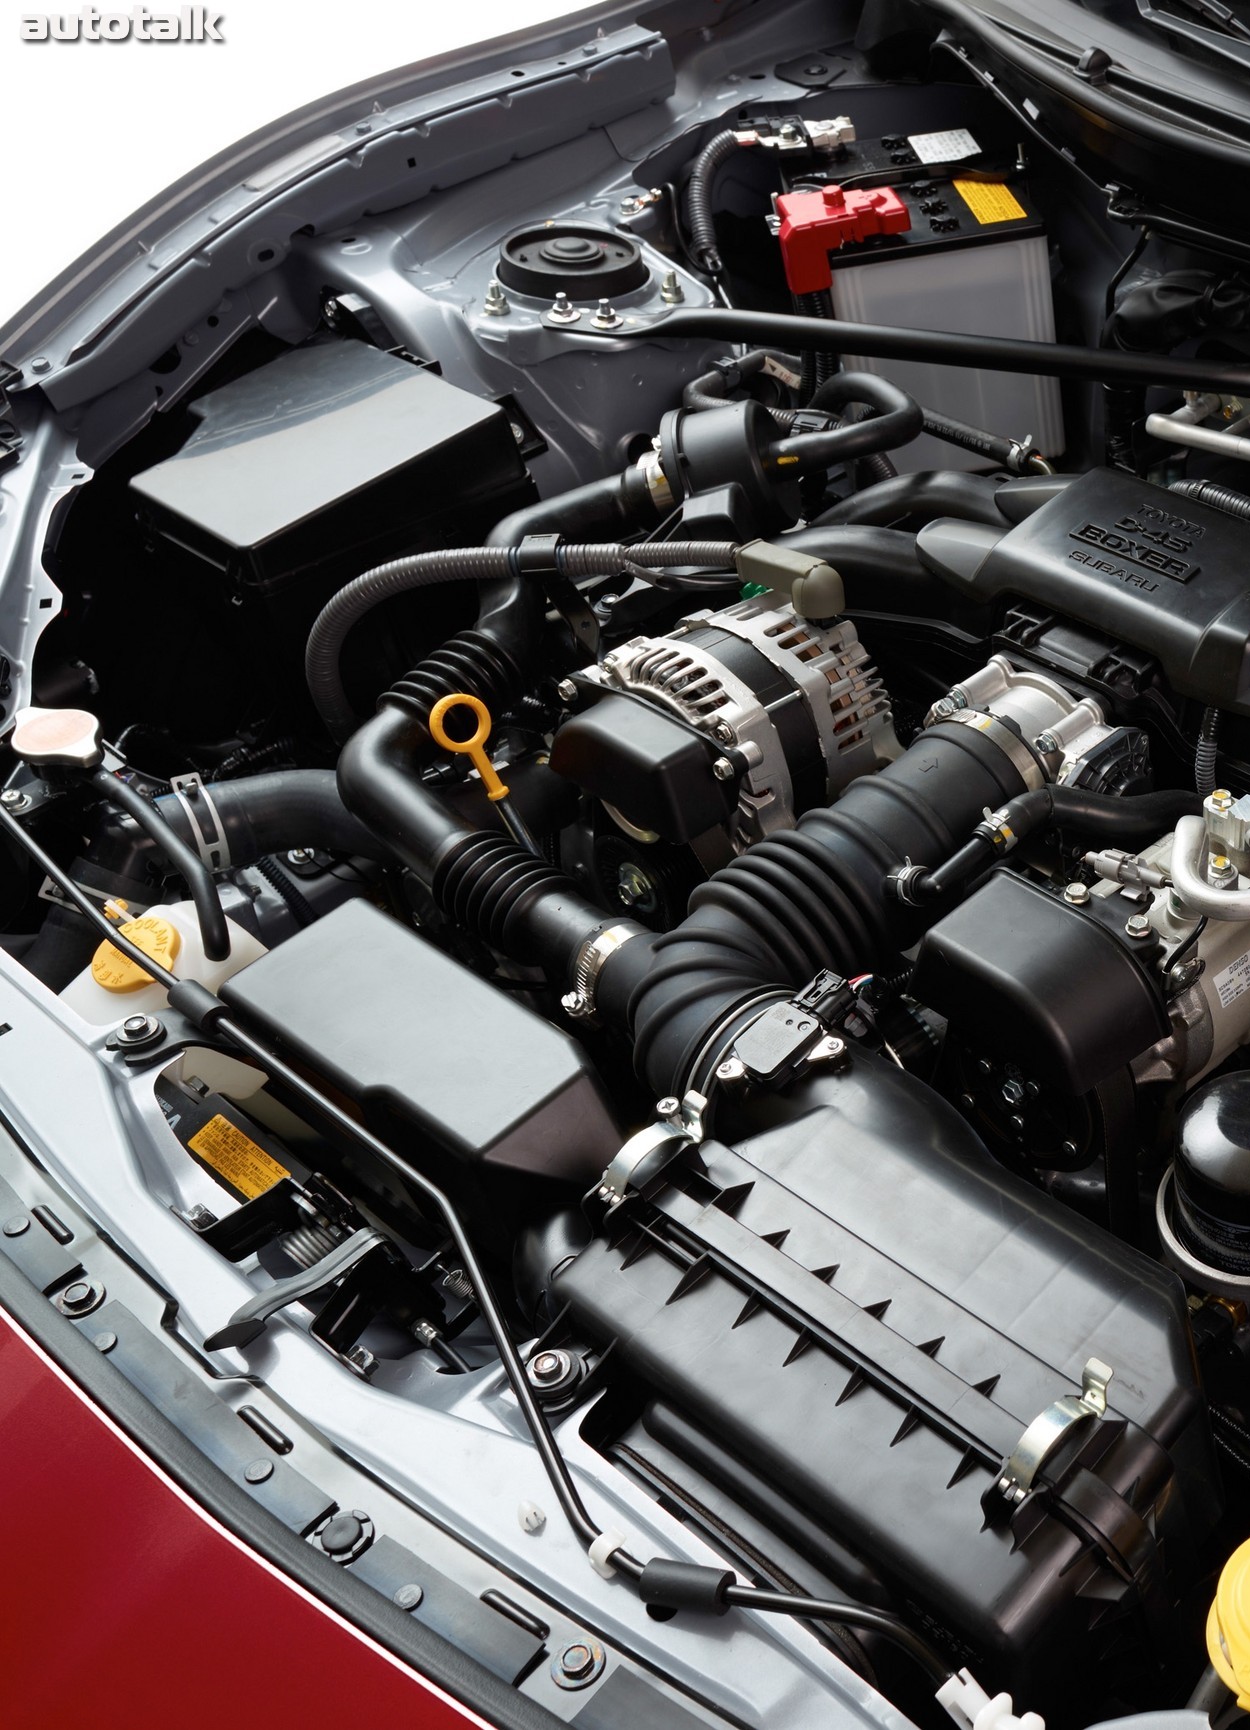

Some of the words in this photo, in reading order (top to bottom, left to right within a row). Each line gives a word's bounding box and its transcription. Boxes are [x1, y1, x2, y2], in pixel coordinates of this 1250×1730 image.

[1137, 504, 1207, 538] TOYOTA
[1077, 523, 1191, 577] BOXER
[1069, 550, 1160, 592] SUBARU
[123, 919, 169, 954] COOLANT
[1229, 954, 1249, 975] DENSO
[231, 1129, 250, 1146] CAUTION
[249, 1145, 273, 1166] ATTENTION
